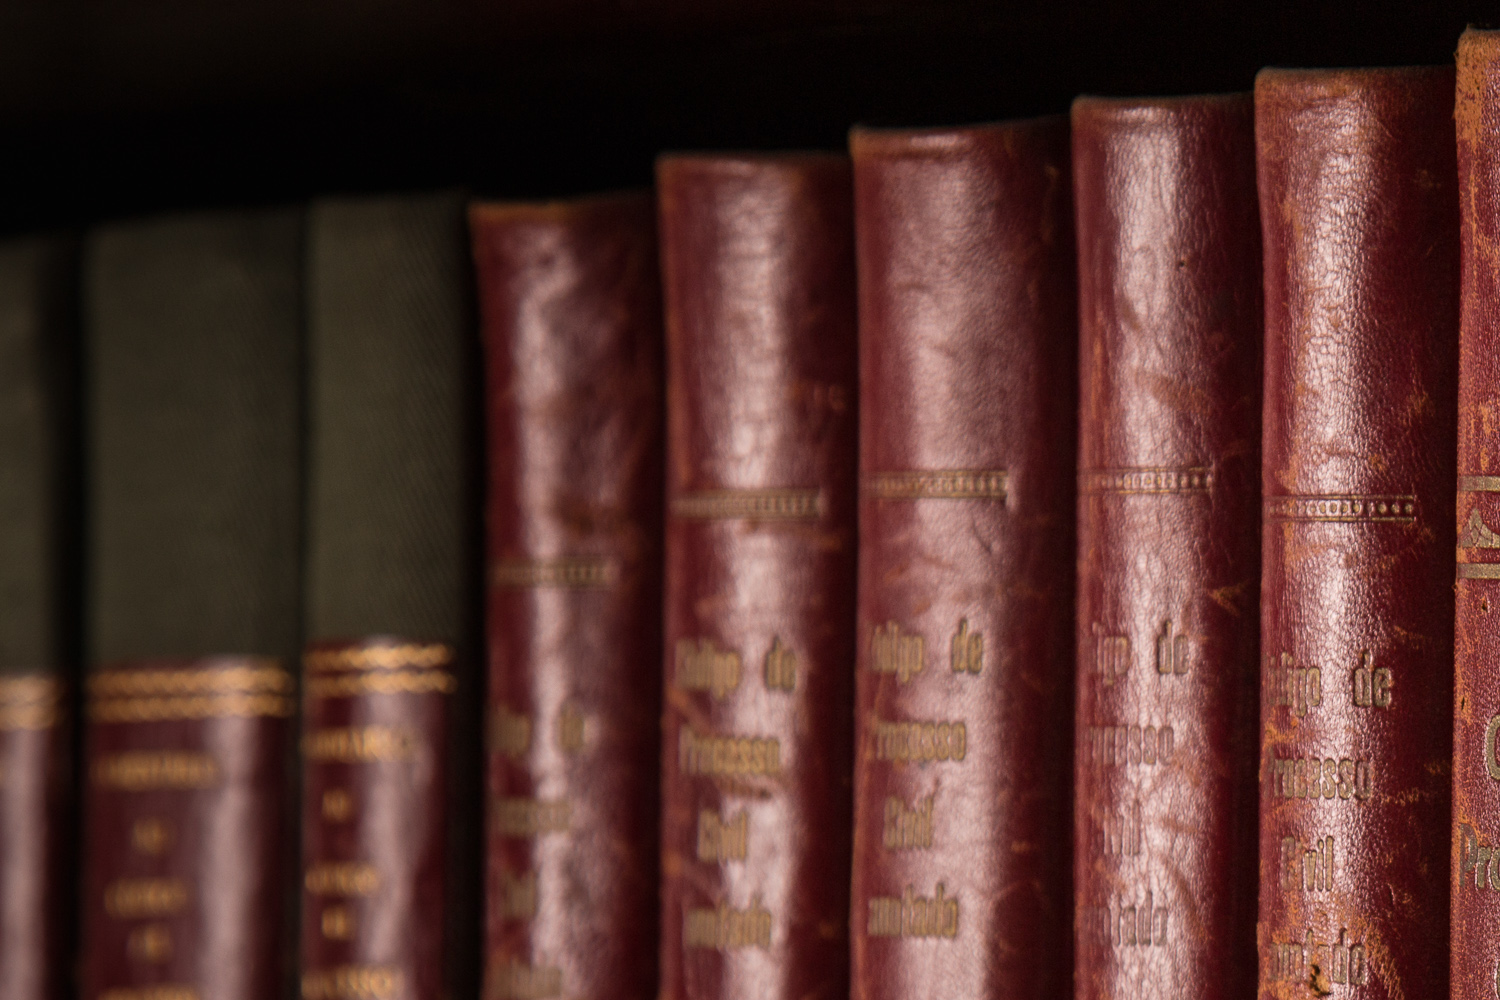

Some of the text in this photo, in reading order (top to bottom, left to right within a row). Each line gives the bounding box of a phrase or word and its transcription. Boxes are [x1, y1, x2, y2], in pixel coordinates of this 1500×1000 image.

[951, 617, 983, 676] de
[1156, 619, 1191, 676] de
[1353, 652, 1393, 708] de
